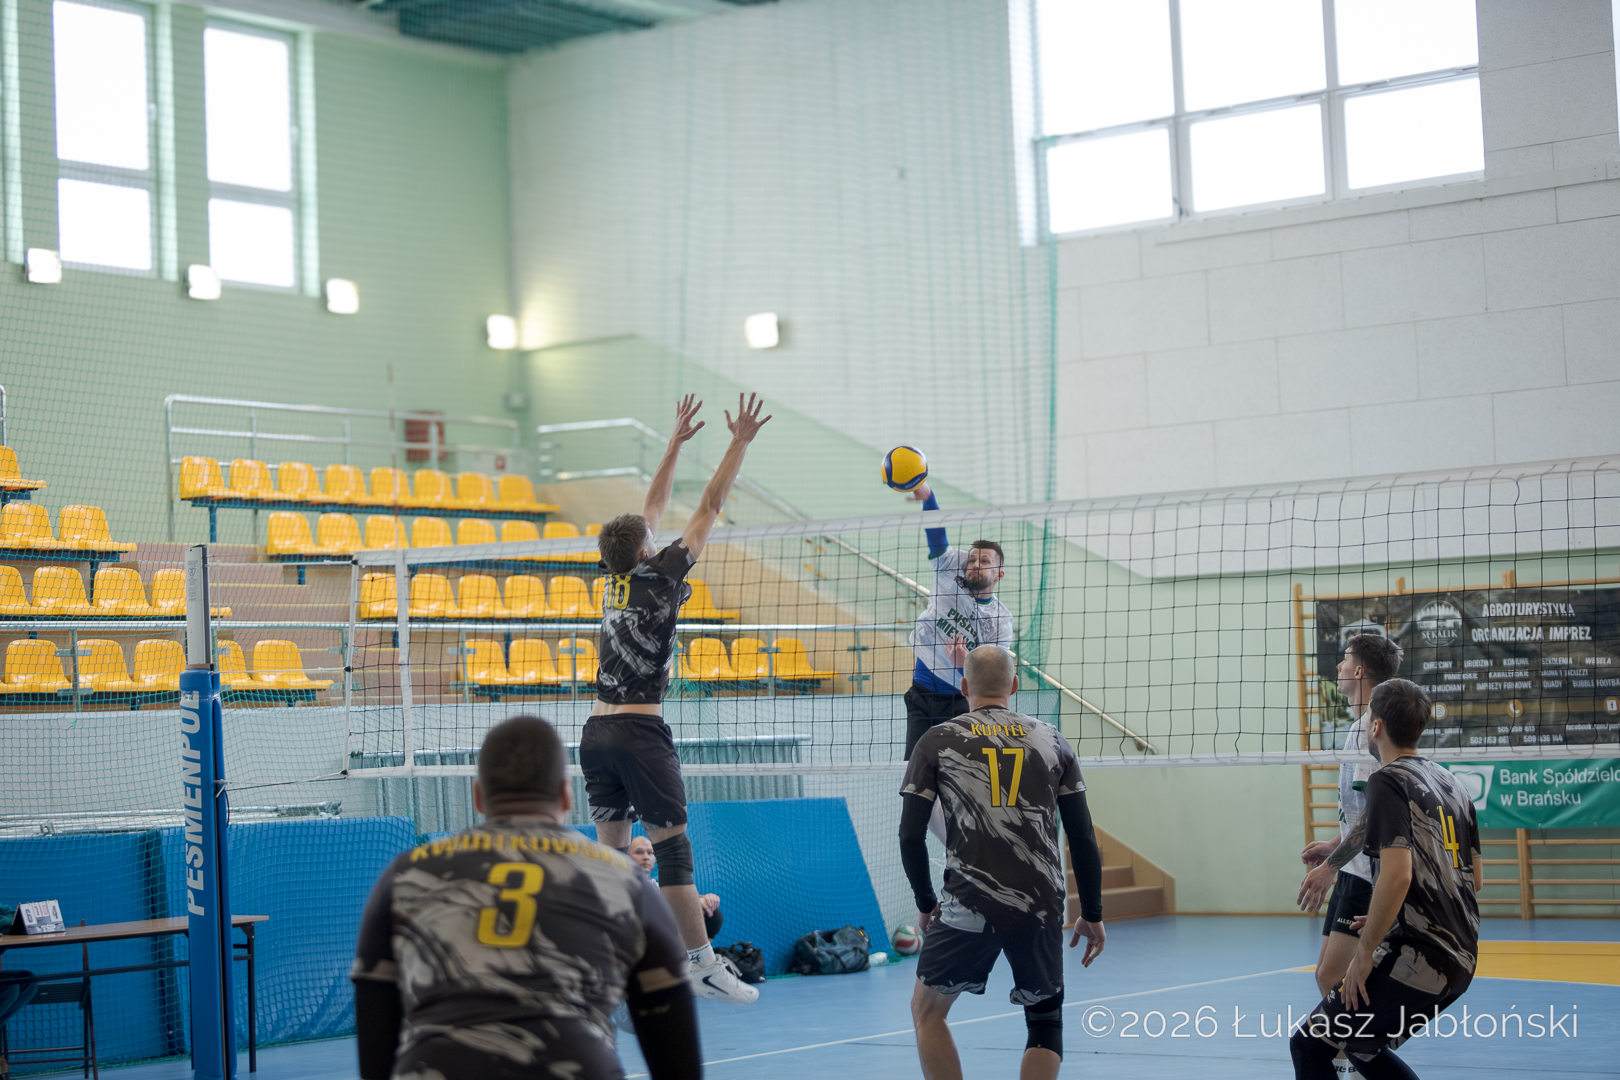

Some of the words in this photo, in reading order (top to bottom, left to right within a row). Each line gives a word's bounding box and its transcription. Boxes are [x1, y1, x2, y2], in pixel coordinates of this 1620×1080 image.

[1482, 602, 1576, 617] AGROTURYSTYKA
[1471, 626, 1544, 642] ORGANIZACJA
[1549, 626, 1592, 641] IMPREZ
[1585, 656, 1612, 666] WESELA
[971, 723, 1027, 737] KUPTEL
[982, 747, 1024, 807] 17
[1500, 768, 1538, 785] Bank
[180, 690, 205, 916] PESMENPOL
[1500, 793, 1513, 806] w
[1517, 790, 1581, 806] Brańsku
[1438, 805, 1459, 868] 4
[478, 862, 544, 947] 3
